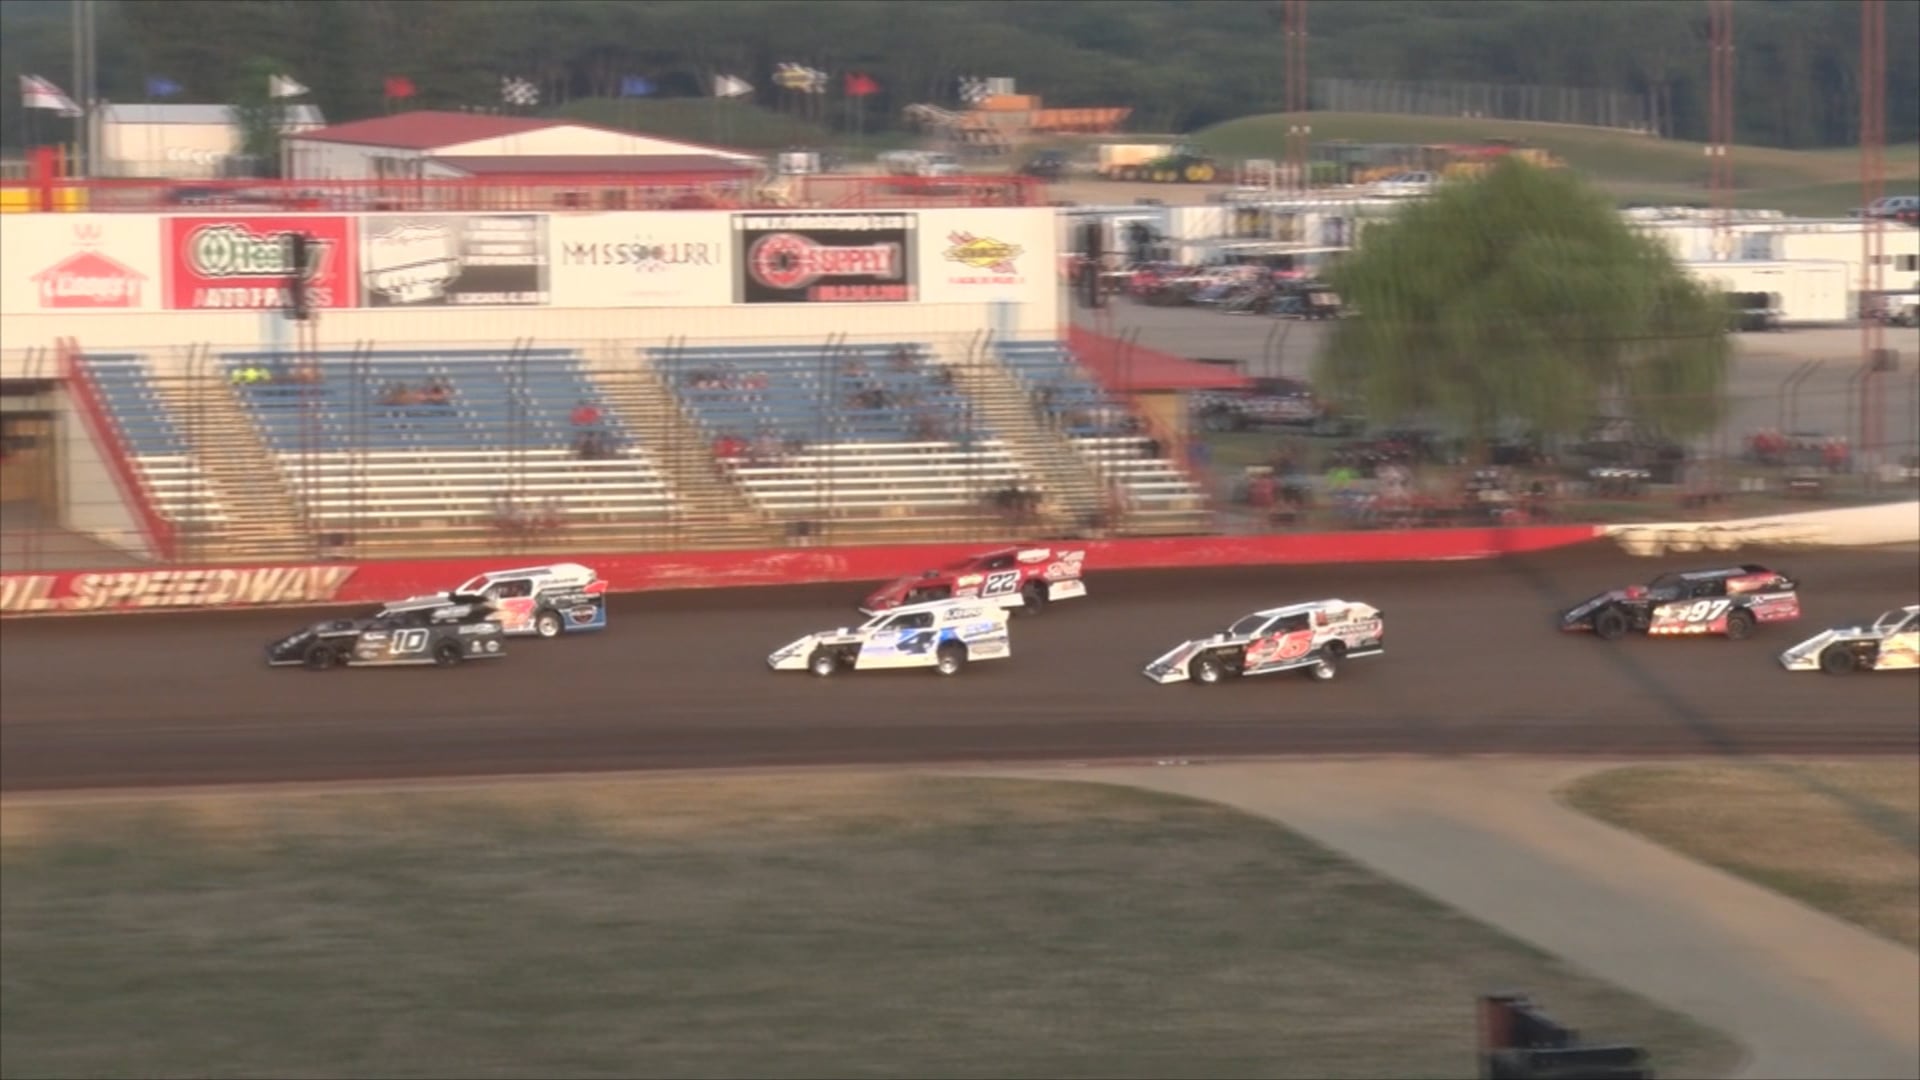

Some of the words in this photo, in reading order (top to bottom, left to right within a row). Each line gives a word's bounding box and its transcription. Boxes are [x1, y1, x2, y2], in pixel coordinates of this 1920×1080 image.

[65, 566, 358, 609] SPEEDWAY
[986, 572, 1018, 594] 22
[1687, 599, 1732, 622] 97
[390, 628, 430, 655] 10
